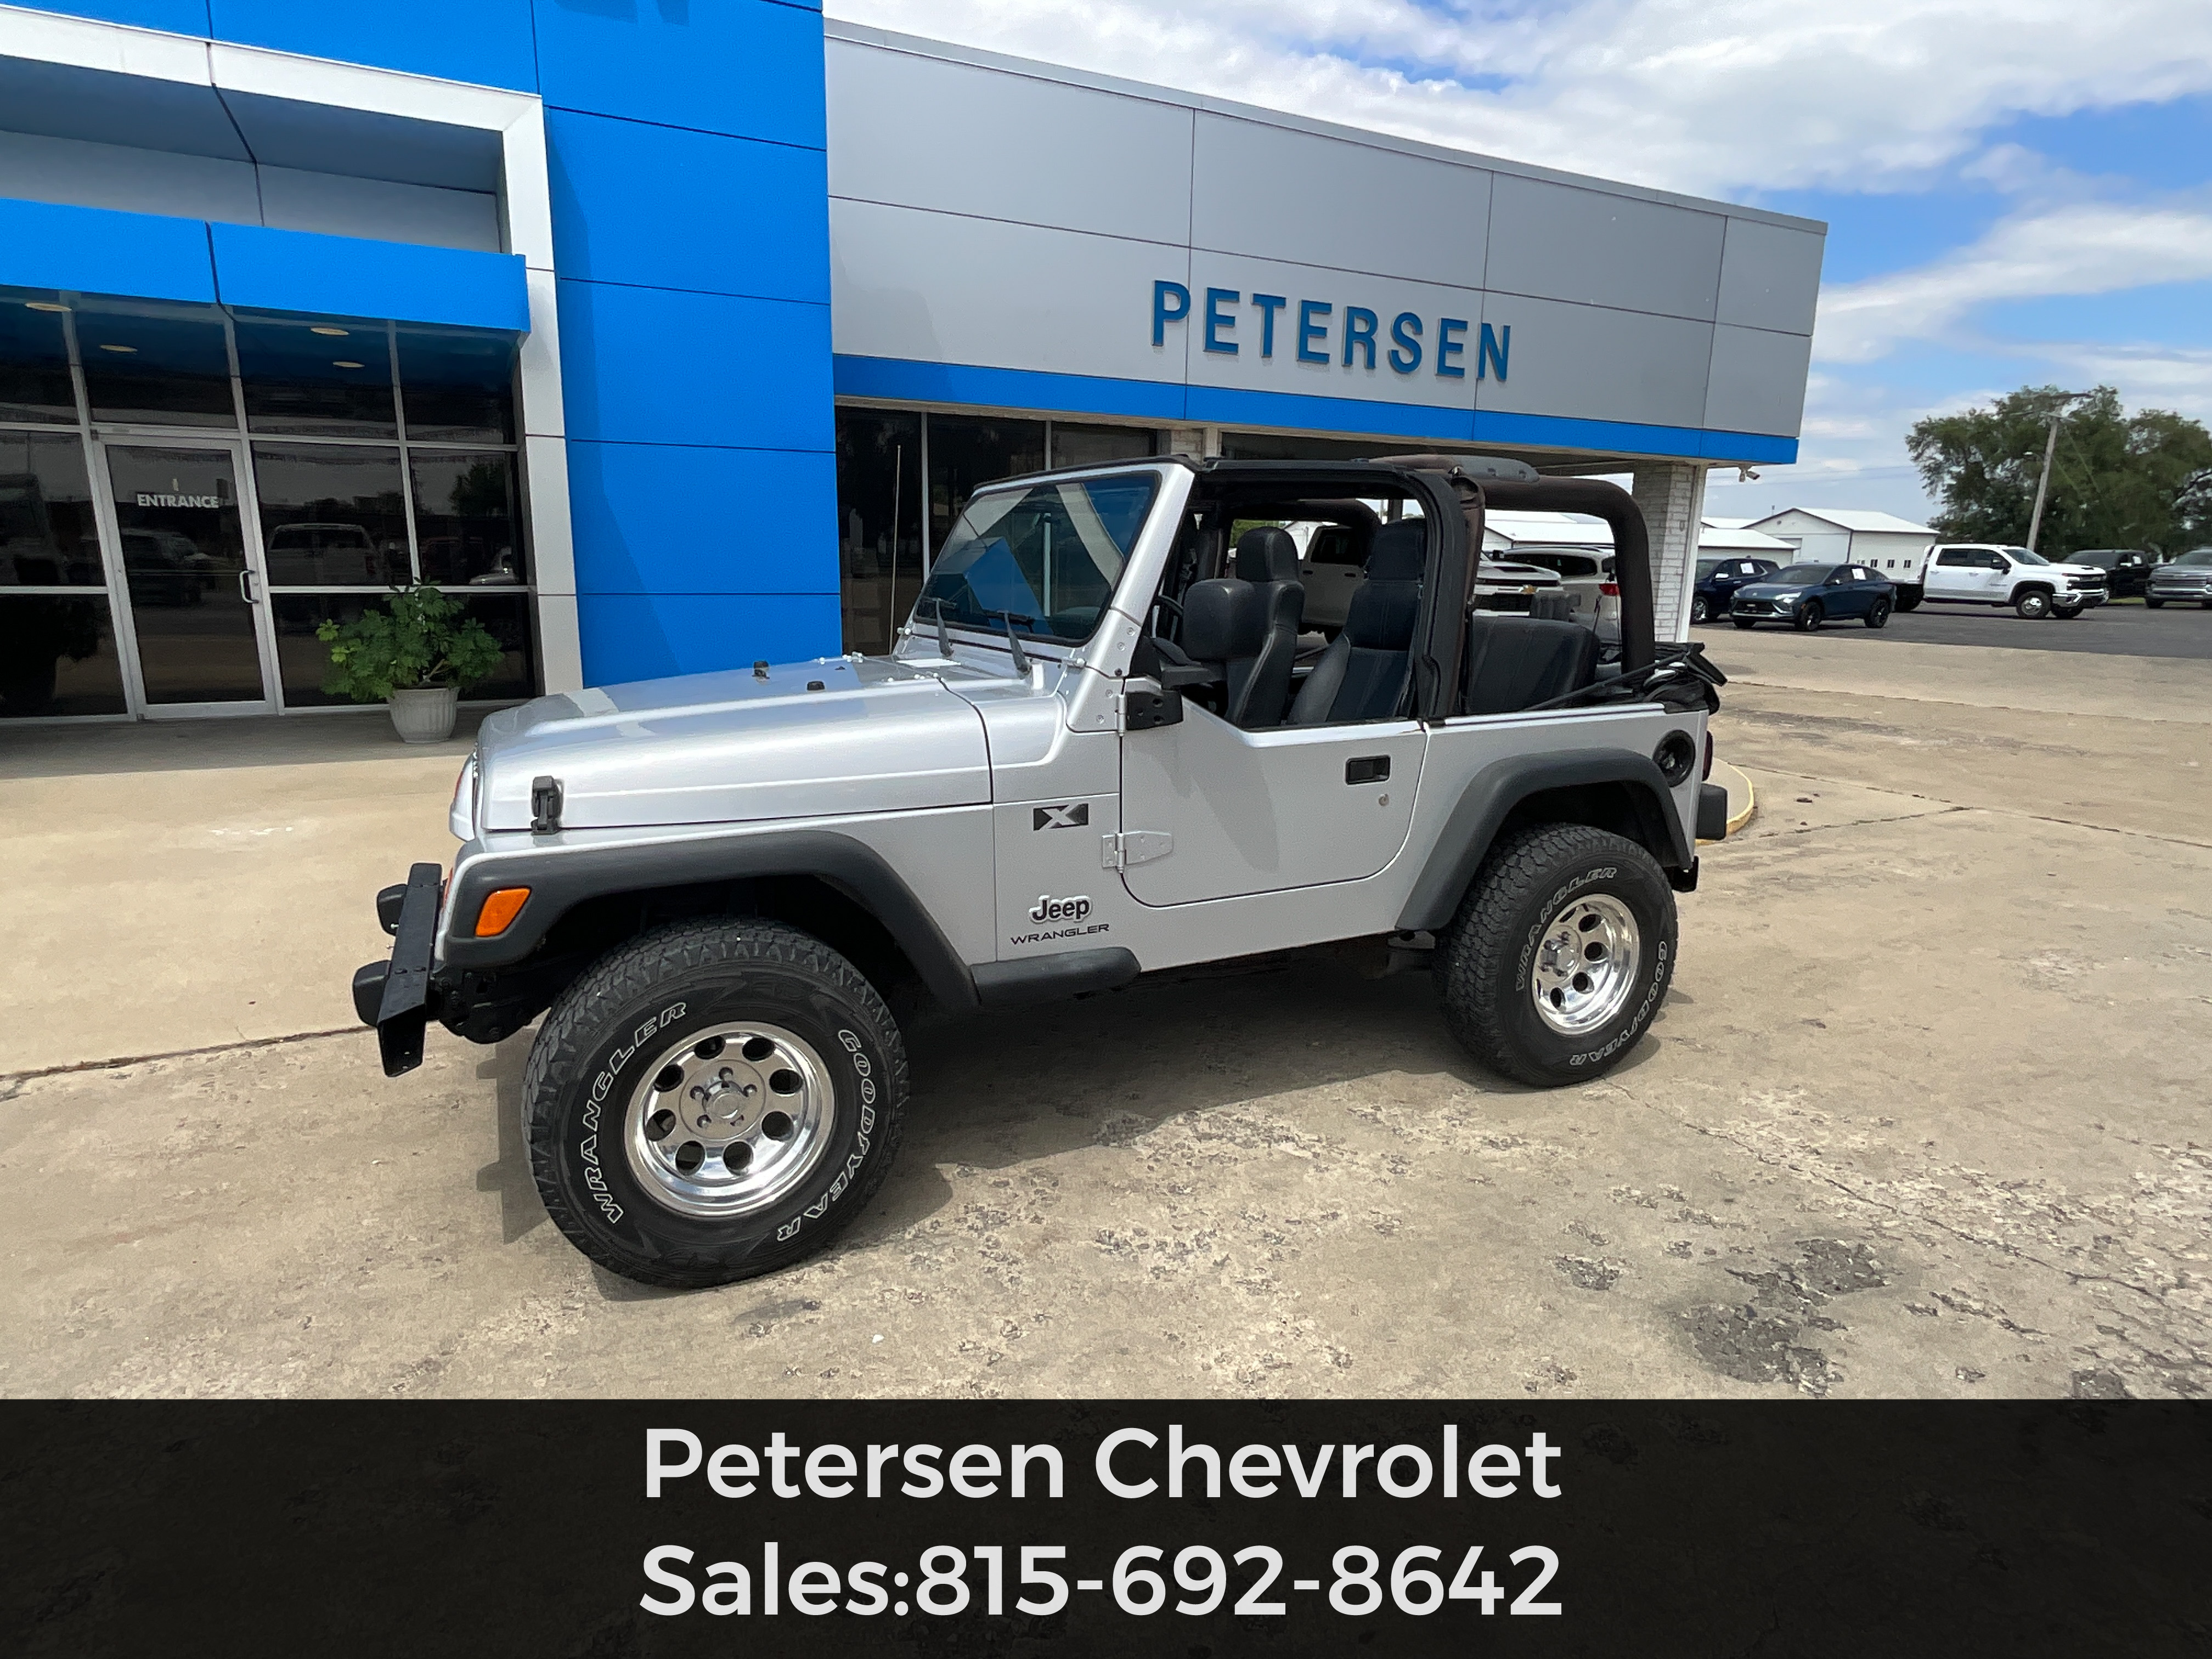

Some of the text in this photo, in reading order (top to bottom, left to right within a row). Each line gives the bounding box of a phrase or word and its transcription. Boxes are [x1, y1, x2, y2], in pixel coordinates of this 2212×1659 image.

[1151, 280, 1511, 382] PETERSEN
[137, 494, 219, 508] ENTRANCE
[1011, 924, 1109, 945] WRANGLER
[1030, 896, 1091, 923] Jeep
[1516, 867, 1617, 991] WRANGLER
[1569, 941, 1668, 1066] GOODYEAR
[580, 1002, 687, 1223] WRANGLER
[777, 1029, 876, 1242] GOODYEAR
